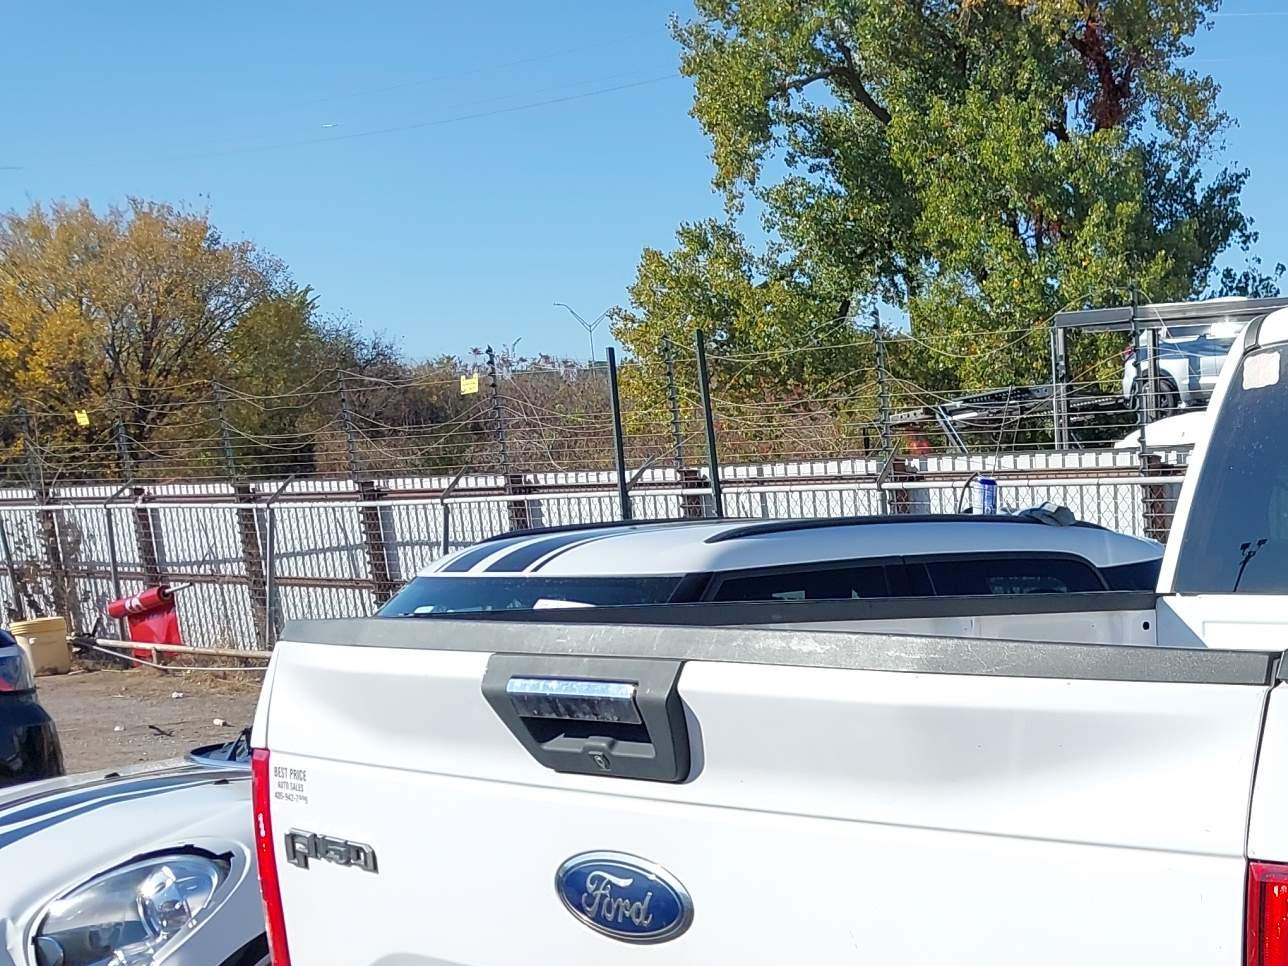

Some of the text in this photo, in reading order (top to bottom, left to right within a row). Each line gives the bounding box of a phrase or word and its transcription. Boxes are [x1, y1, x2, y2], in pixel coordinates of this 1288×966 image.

[274, 766, 307, 782] BEST PRICE
[290, 782, 304, 792] SALES
[582, 871, 653, 926] Ford
